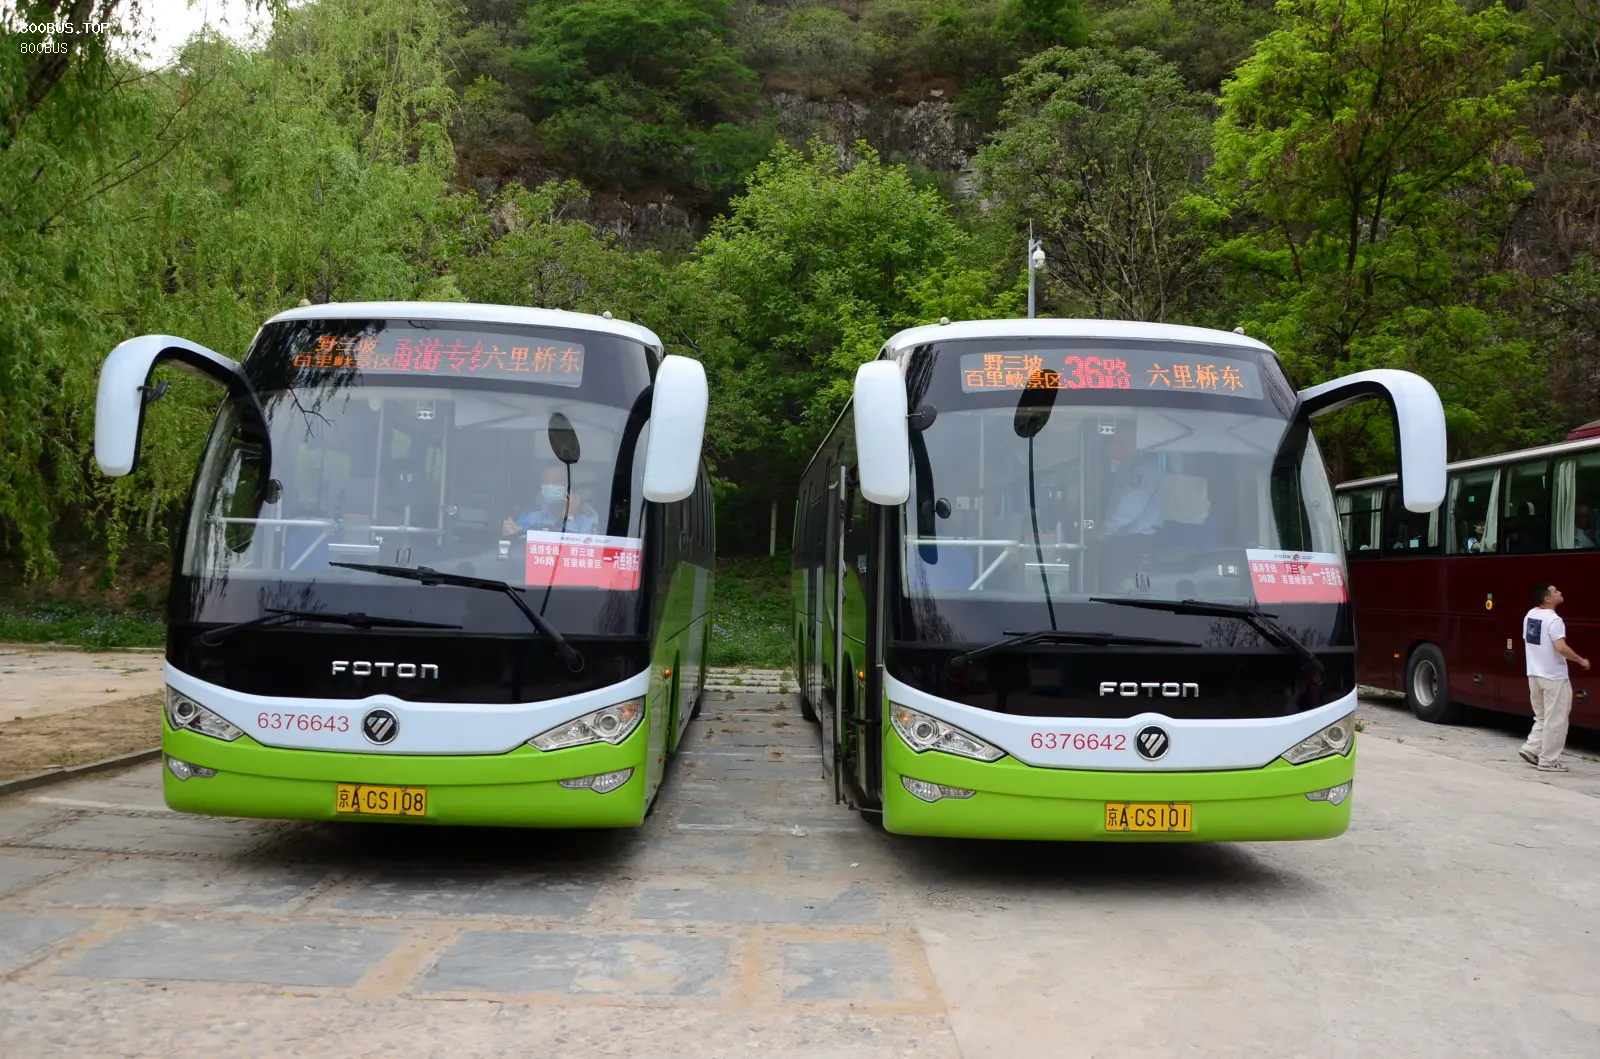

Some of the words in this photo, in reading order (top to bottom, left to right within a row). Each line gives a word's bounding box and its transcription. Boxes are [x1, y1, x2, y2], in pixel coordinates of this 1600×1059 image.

[482, 344, 581, 374] 六里桥东
[983, 354, 1044, 372] 野三坡
[964, 369, 1065, 389] 百里峡景区
[1062, 355, 1131, 389] 36路
[1146, 363, 1244, 391] 六里桥东
[332, 660, 439, 679] FOTON
[1099, 681, 1200, 698] FOTON
[257, 712, 350, 733] 6376643
[1030, 732, 1127, 751] 6376642
